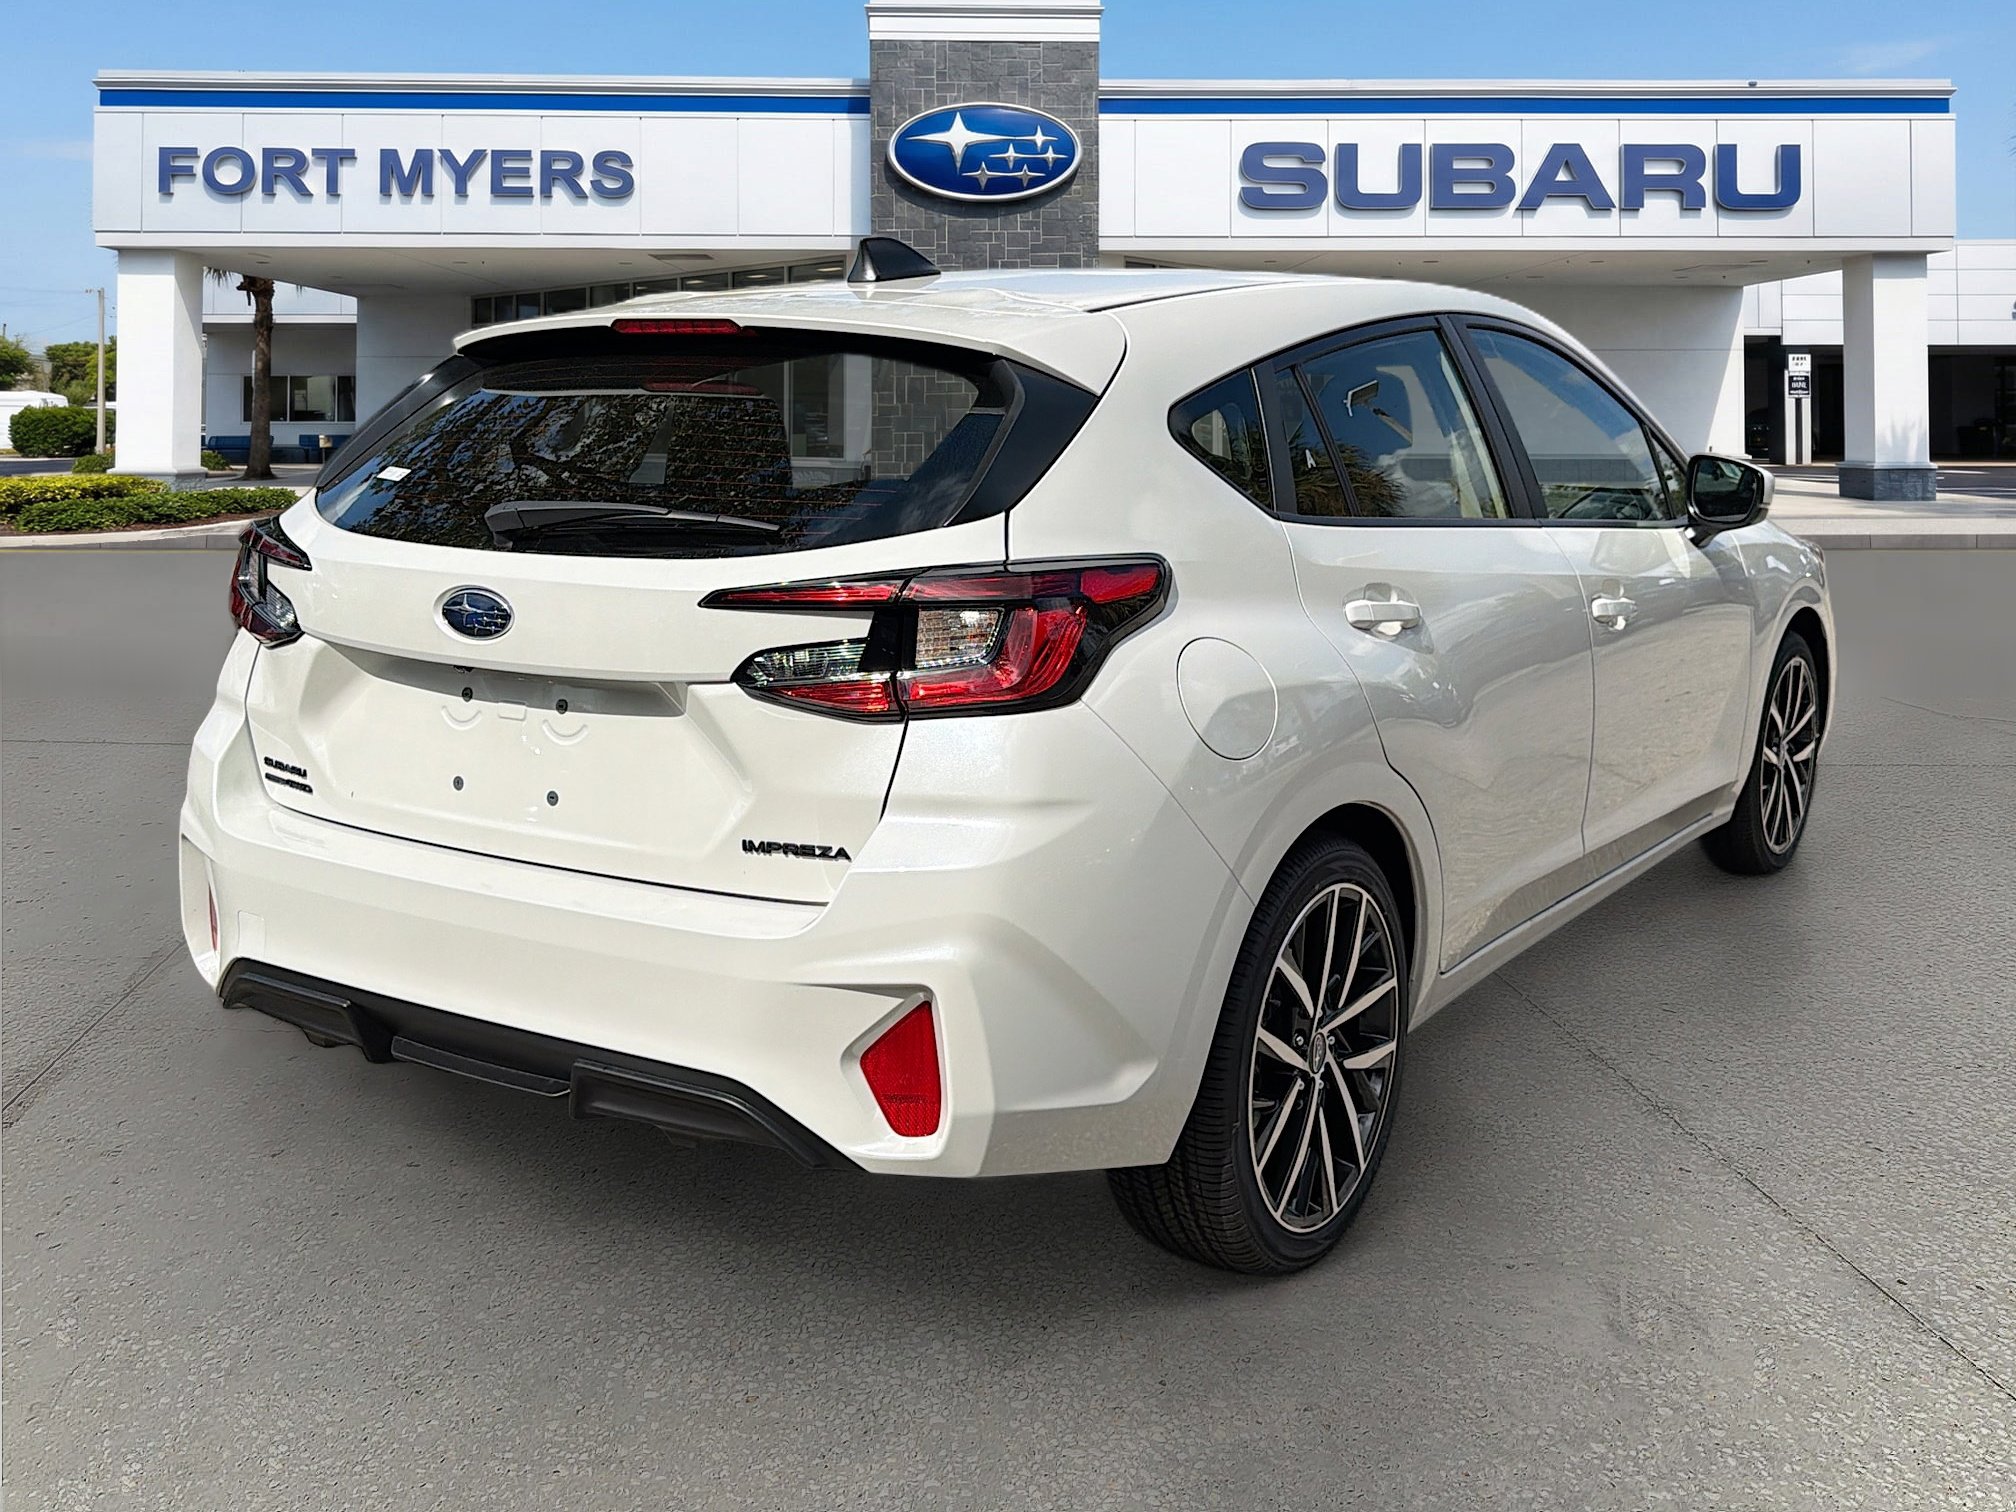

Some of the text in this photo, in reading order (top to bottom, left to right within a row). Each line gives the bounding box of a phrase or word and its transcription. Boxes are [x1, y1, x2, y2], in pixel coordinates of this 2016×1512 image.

[158, 146, 635, 198] FORT MYERS
[1239, 142, 1802, 211] SUBARU
[742, 839, 852, 862] IMPREZA
